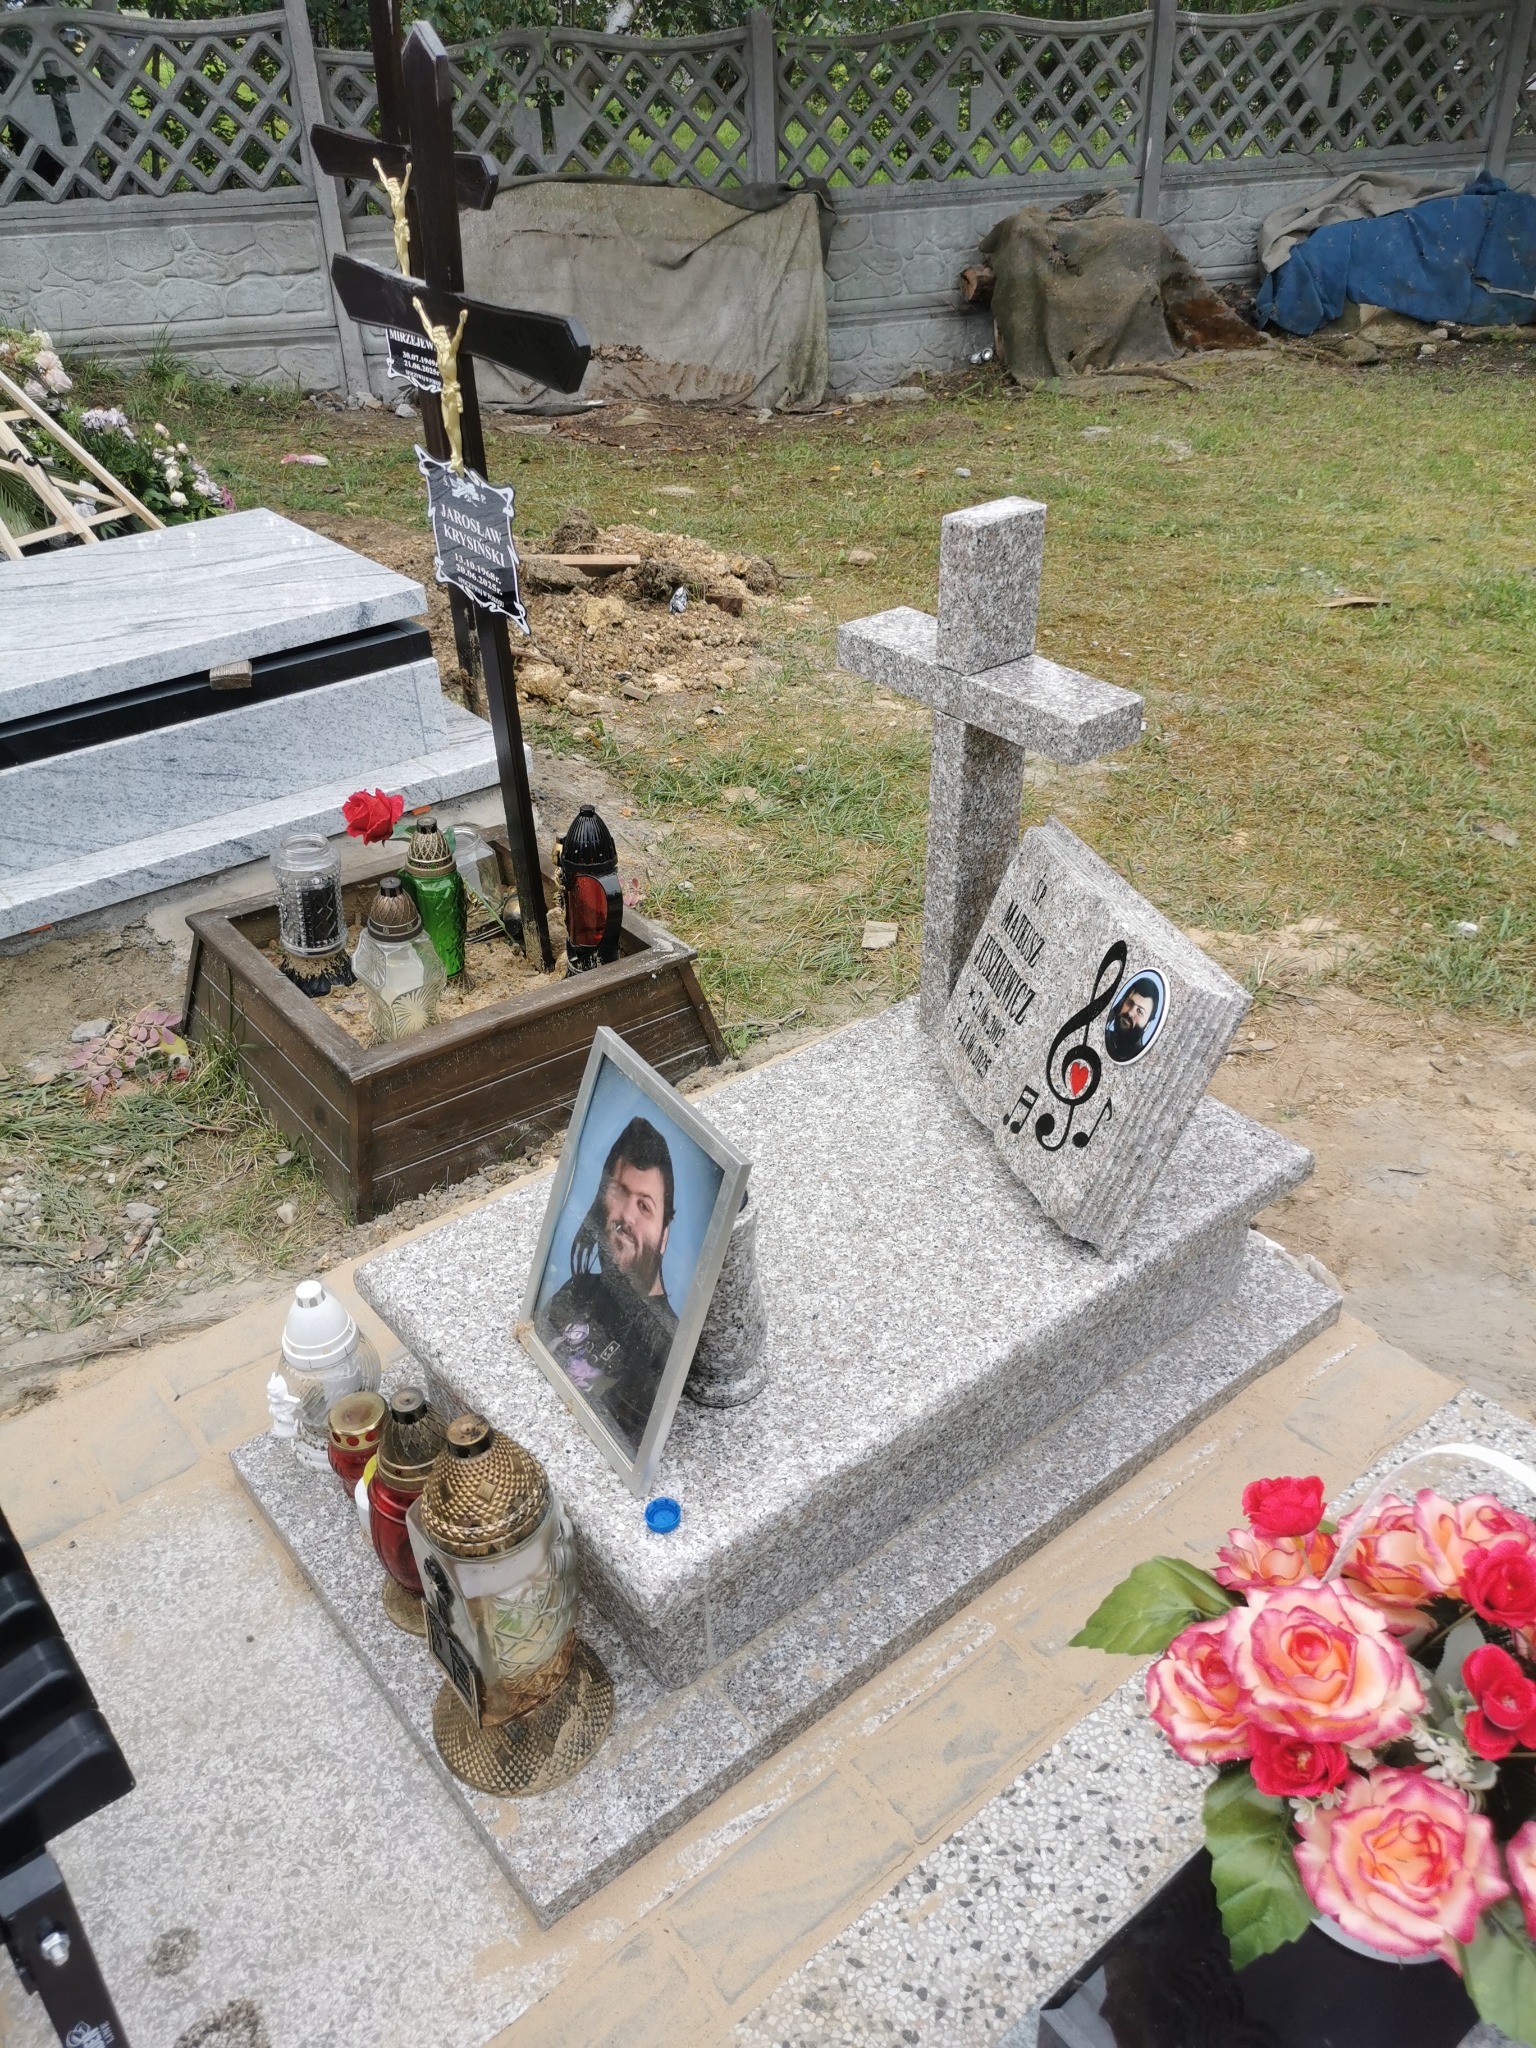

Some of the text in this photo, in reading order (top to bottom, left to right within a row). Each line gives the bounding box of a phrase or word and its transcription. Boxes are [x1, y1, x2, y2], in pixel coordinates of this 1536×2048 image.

[389, 328, 437, 351] MIRZEJEW
[441, 503, 502, 545] JAROSŁAW
[443, 523, 506, 568] KRYSIŃSKI
[455, 552, 502, 585] 13.10.1968r.
[455, 564, 503, 596] 20.06.2025r.
[1000, 899, 1046, 968] MATEUSZ
[974, 932, 1036, 1026] JUSZKIEWICZ
